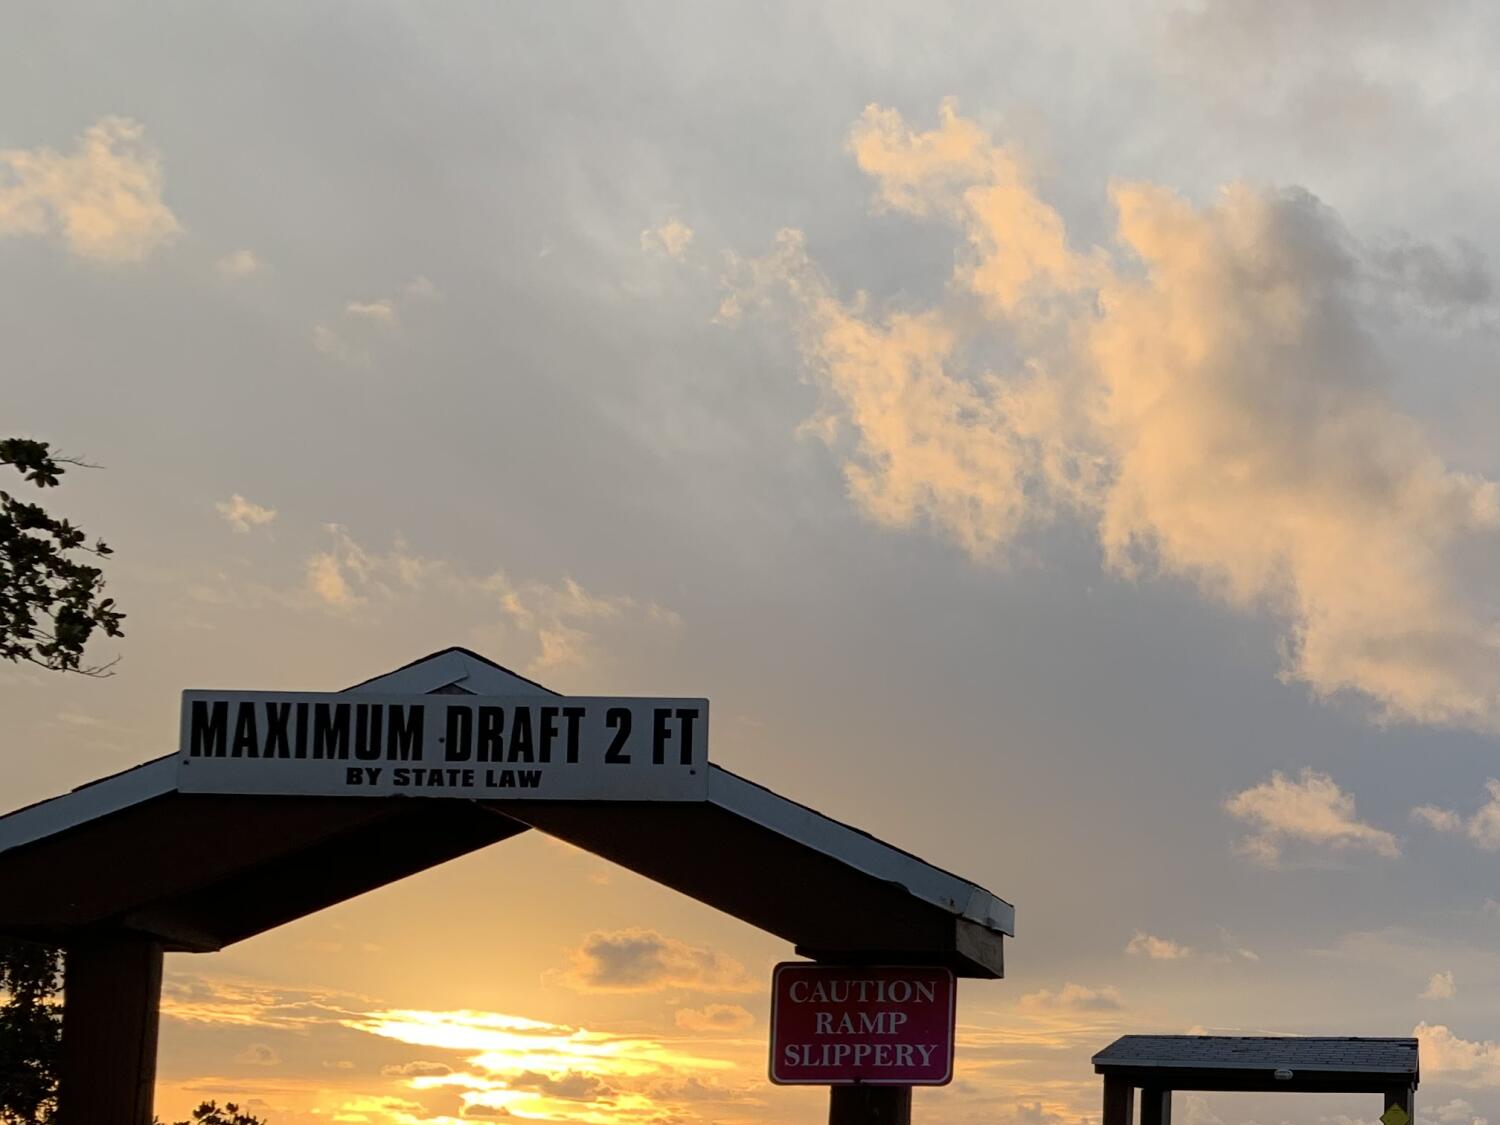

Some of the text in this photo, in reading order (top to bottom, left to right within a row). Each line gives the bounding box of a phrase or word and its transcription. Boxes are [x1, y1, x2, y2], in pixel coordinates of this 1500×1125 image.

[190, 700, 699, 766] MAXIMUM DRAFT 2 FT
[345, 767, 542, 789] BY STATE LAW
[789, 980, 936, 1003] CAUTION
[815, 1012, 908, 1034] RAMP
[784, 1044, 938, 1067] SLIPPERY
